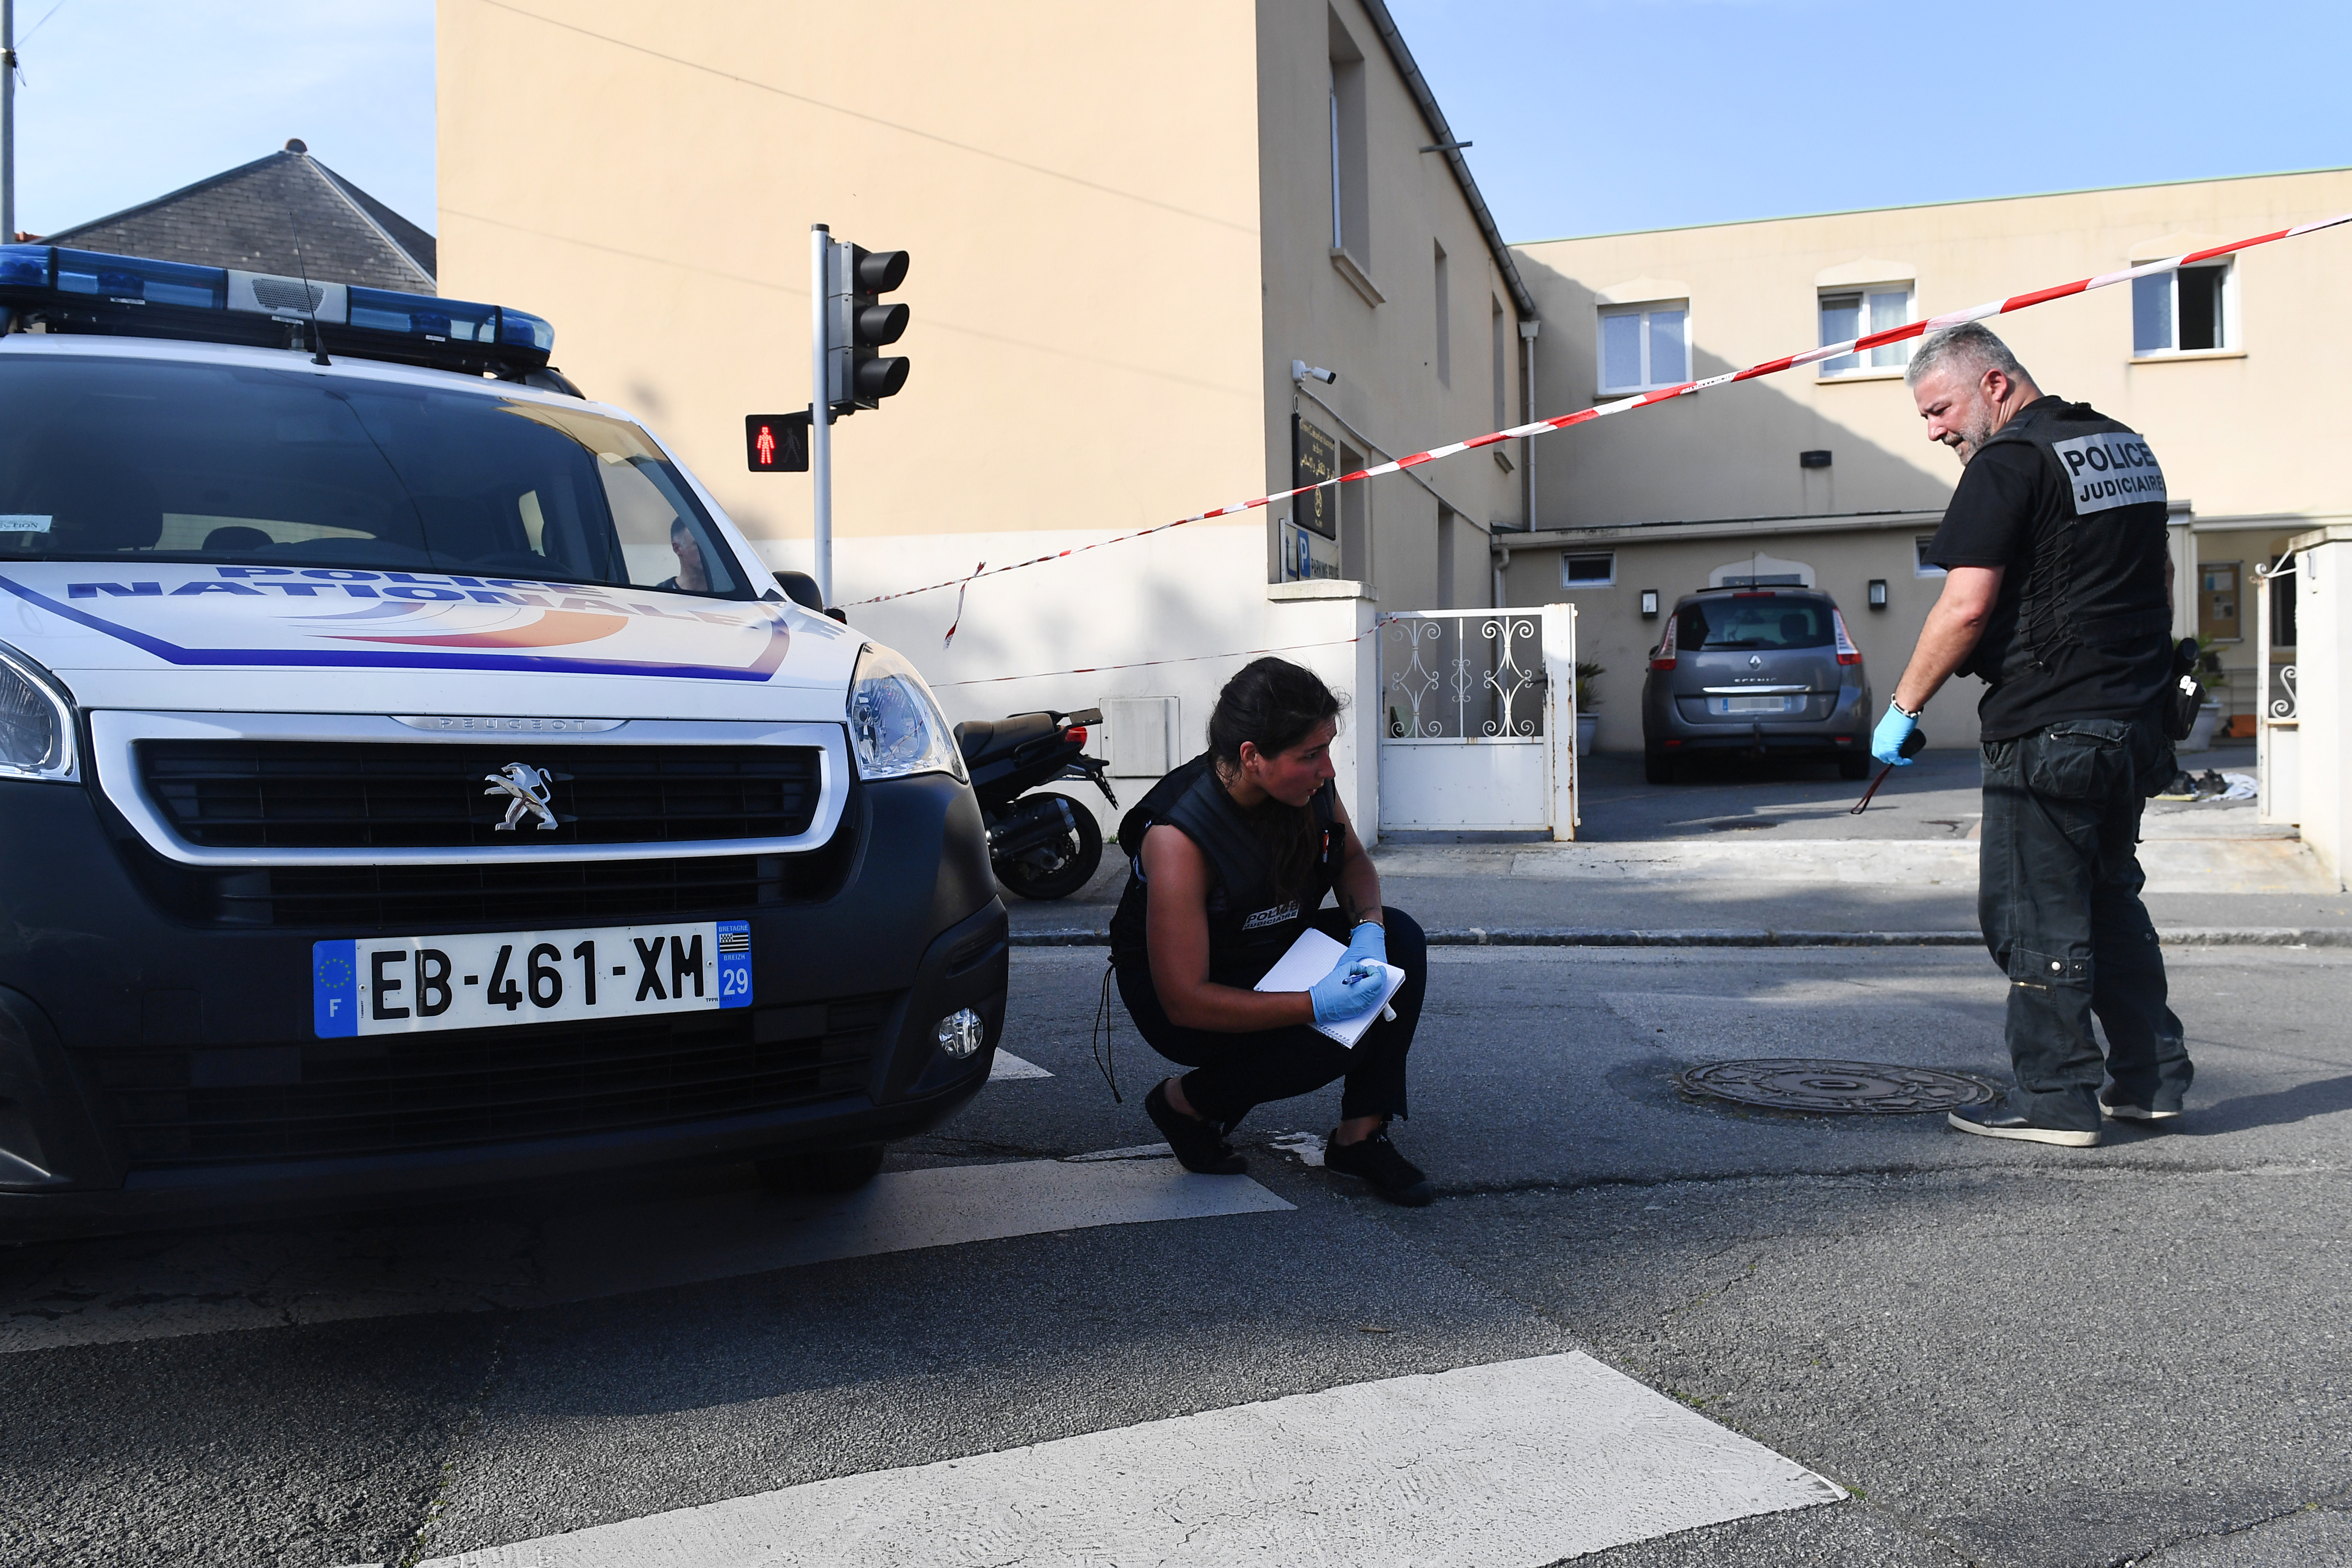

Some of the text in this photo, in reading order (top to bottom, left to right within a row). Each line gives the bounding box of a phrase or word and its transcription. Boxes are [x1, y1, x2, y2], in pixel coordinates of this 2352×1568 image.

[2063, 442, 2157, 476] POLICE
[2080, 475, 2165, 502] JUDICIAIRE
[1300, 537, 1308, 570] P
[216, 567, 612, 598] POLICE
[68, 581, 759, 630] NATIONALE
[439, 718, 588, 731] PEUGEOT
[1245, 911, 1297, 928] JUDICIAIRE
[371, 934, 704, 1020] EB-461-XM
[723, 968, 748, 996] 29
[330, 998, 341, 1017] F
